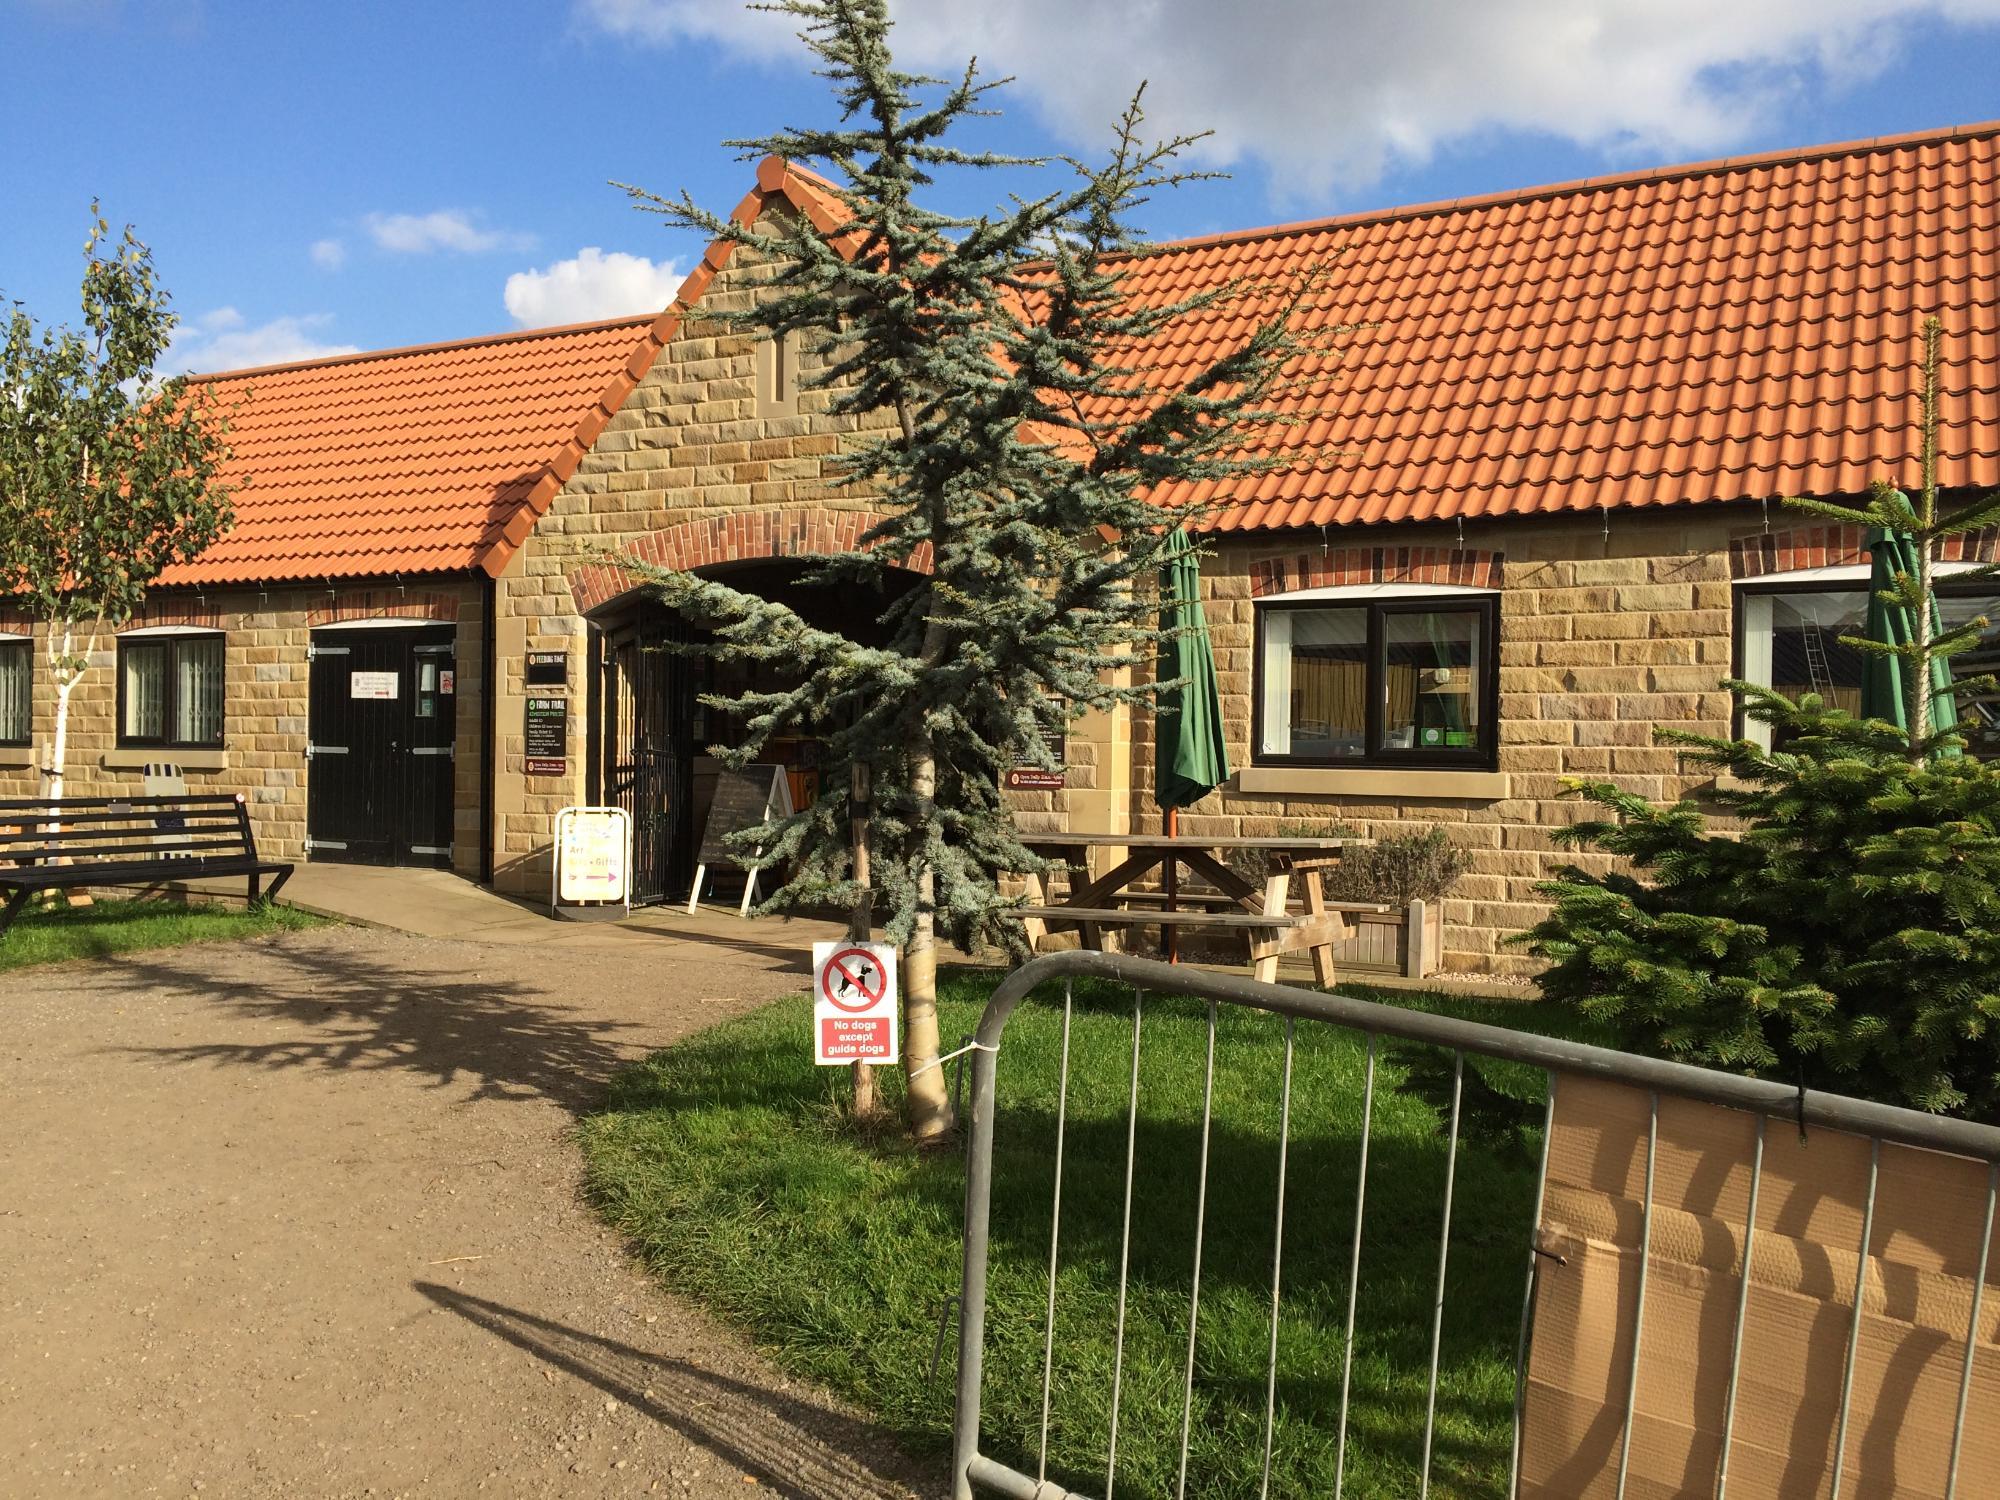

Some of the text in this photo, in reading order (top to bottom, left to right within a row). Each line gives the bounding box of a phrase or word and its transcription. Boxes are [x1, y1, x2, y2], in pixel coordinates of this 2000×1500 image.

[536, 700, 565, 710] FARM TRAIL
[569, 846, 584, 855] Art
[834, 1020, 877, 1031] No dogs
[838, 1032, 874, 1042] except
[828, 1044, 885, 1056] guide dogs
